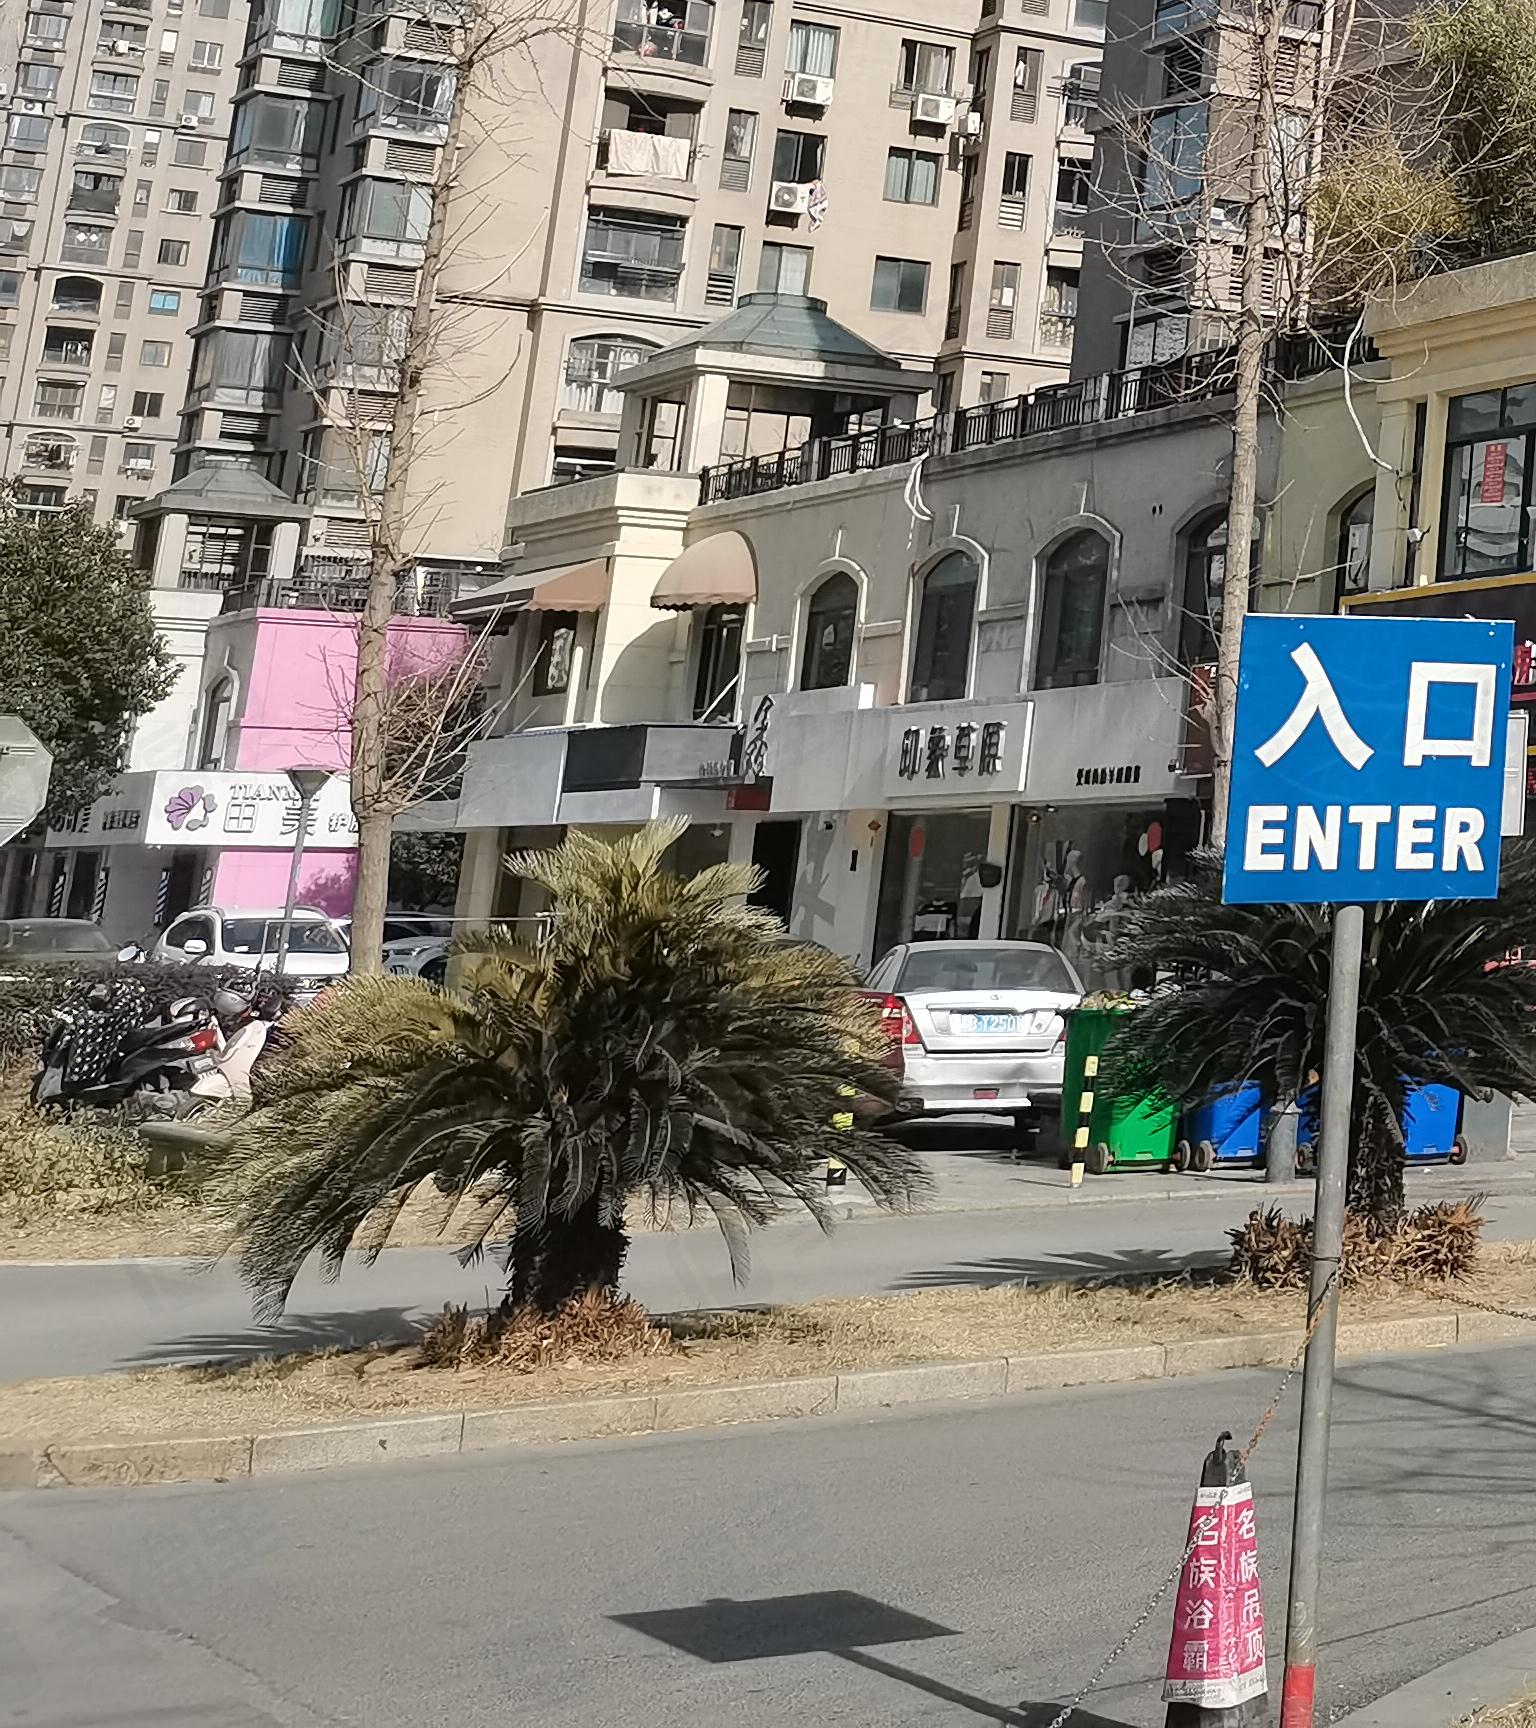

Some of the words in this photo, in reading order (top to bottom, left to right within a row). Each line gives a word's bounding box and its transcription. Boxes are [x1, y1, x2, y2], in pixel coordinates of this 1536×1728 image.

[1254, 642, 1497, 770] 入口
[1243, 805, 1485, 872] ENTER
[1183, 1514, 1219, 1672] 名族浴霸
[1236, 1508, 1264, 1665] 名族吊顶
